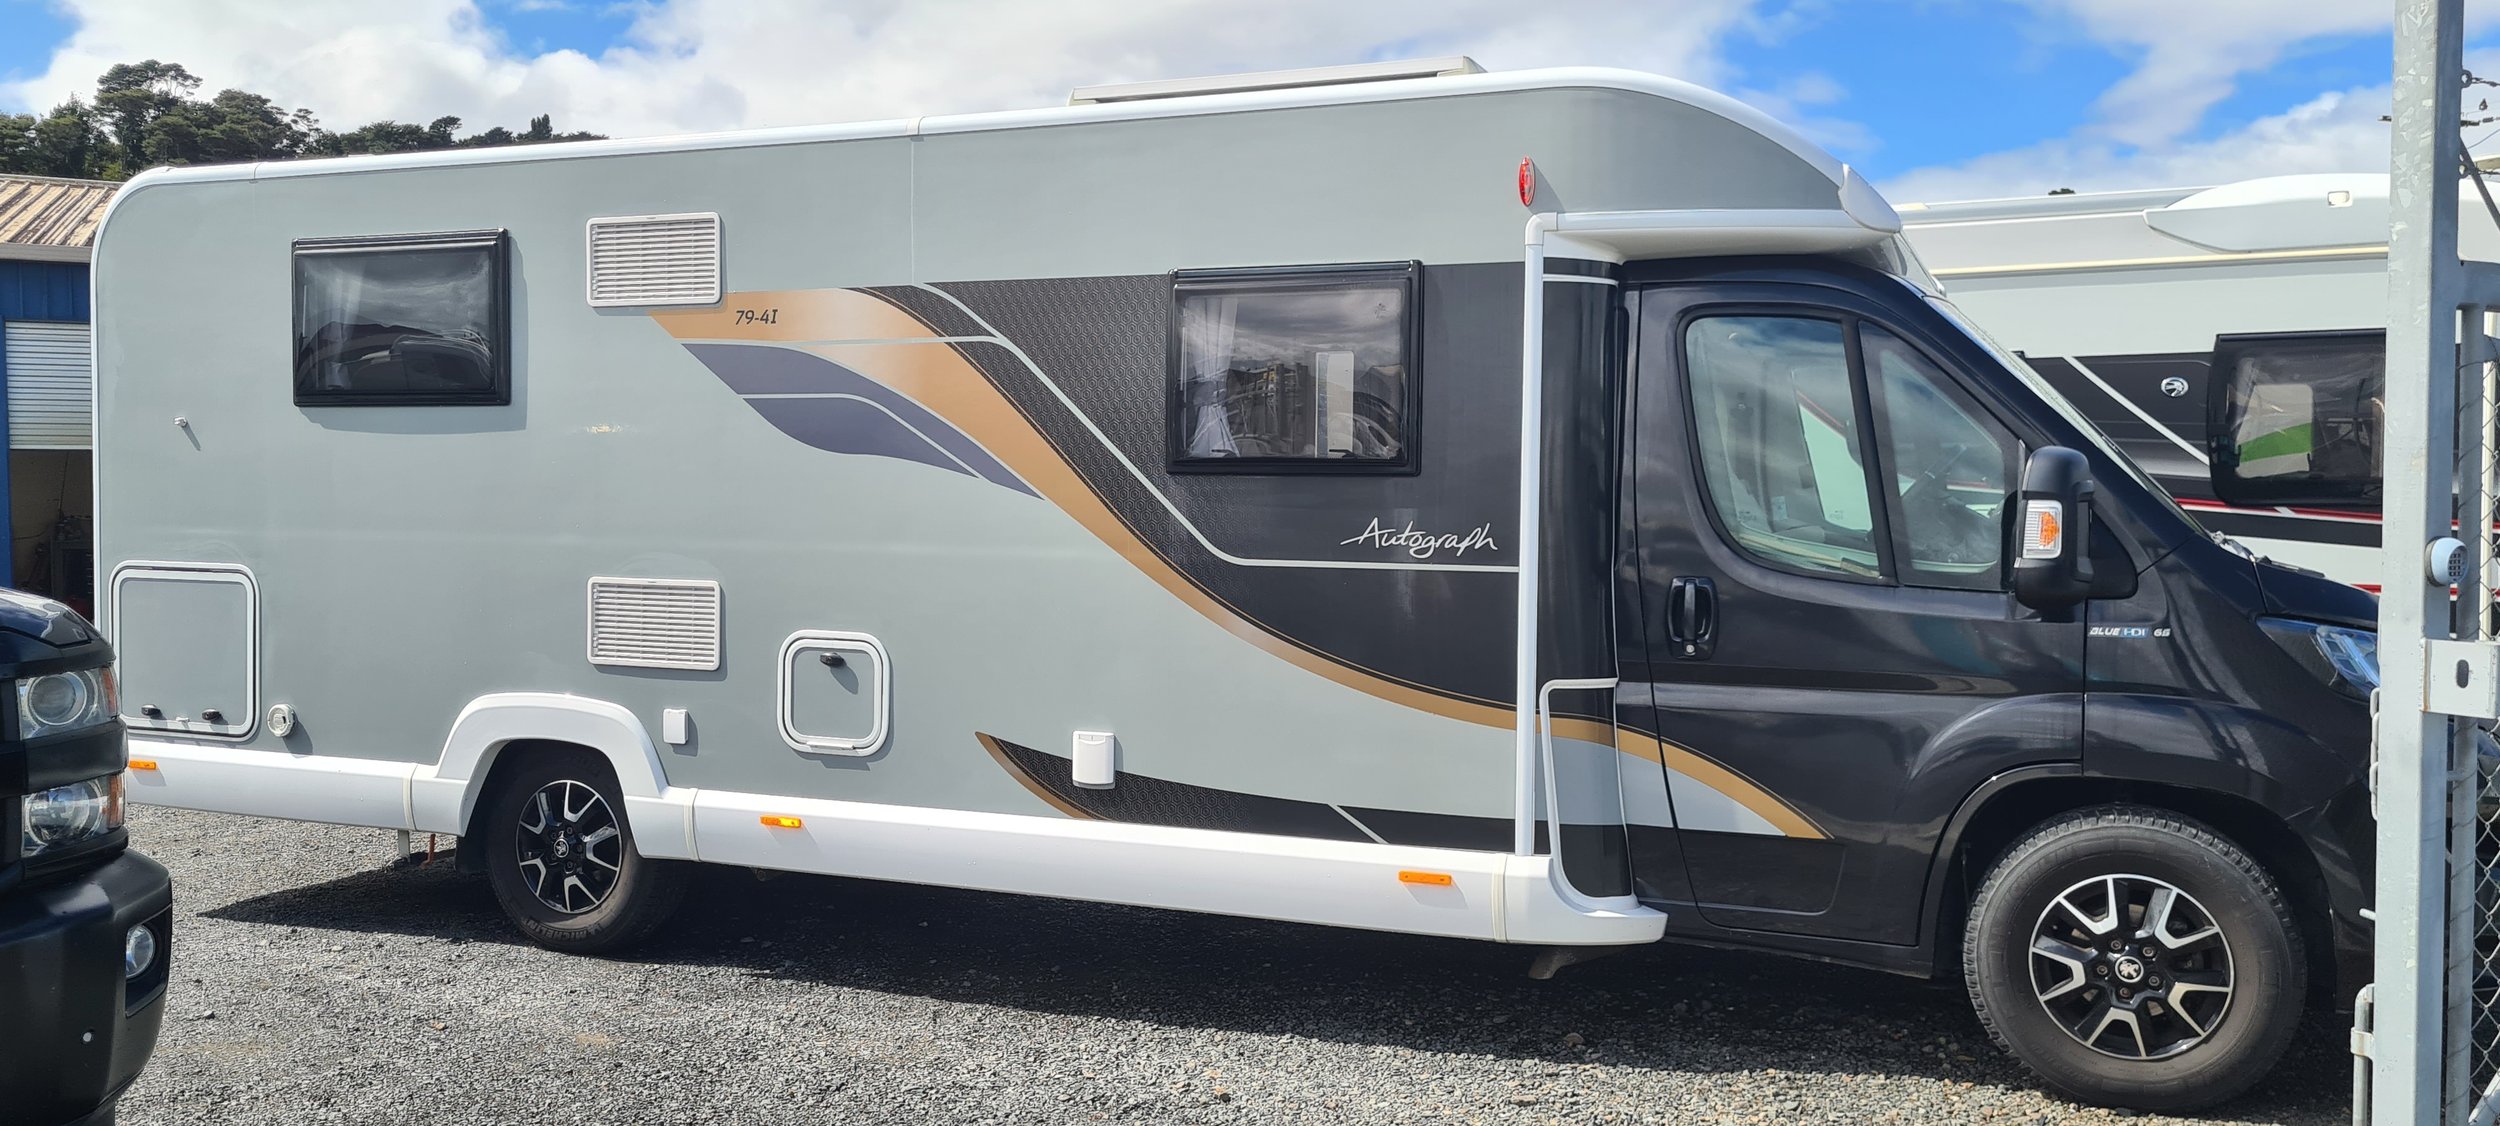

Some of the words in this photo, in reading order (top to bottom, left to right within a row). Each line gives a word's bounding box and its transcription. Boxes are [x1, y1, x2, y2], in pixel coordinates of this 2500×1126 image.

[735, 309, 778, 325] 79-4I
[1340, 517, 1498, 559] Autograph
[527, 918, 587, 941] MICHELIN
